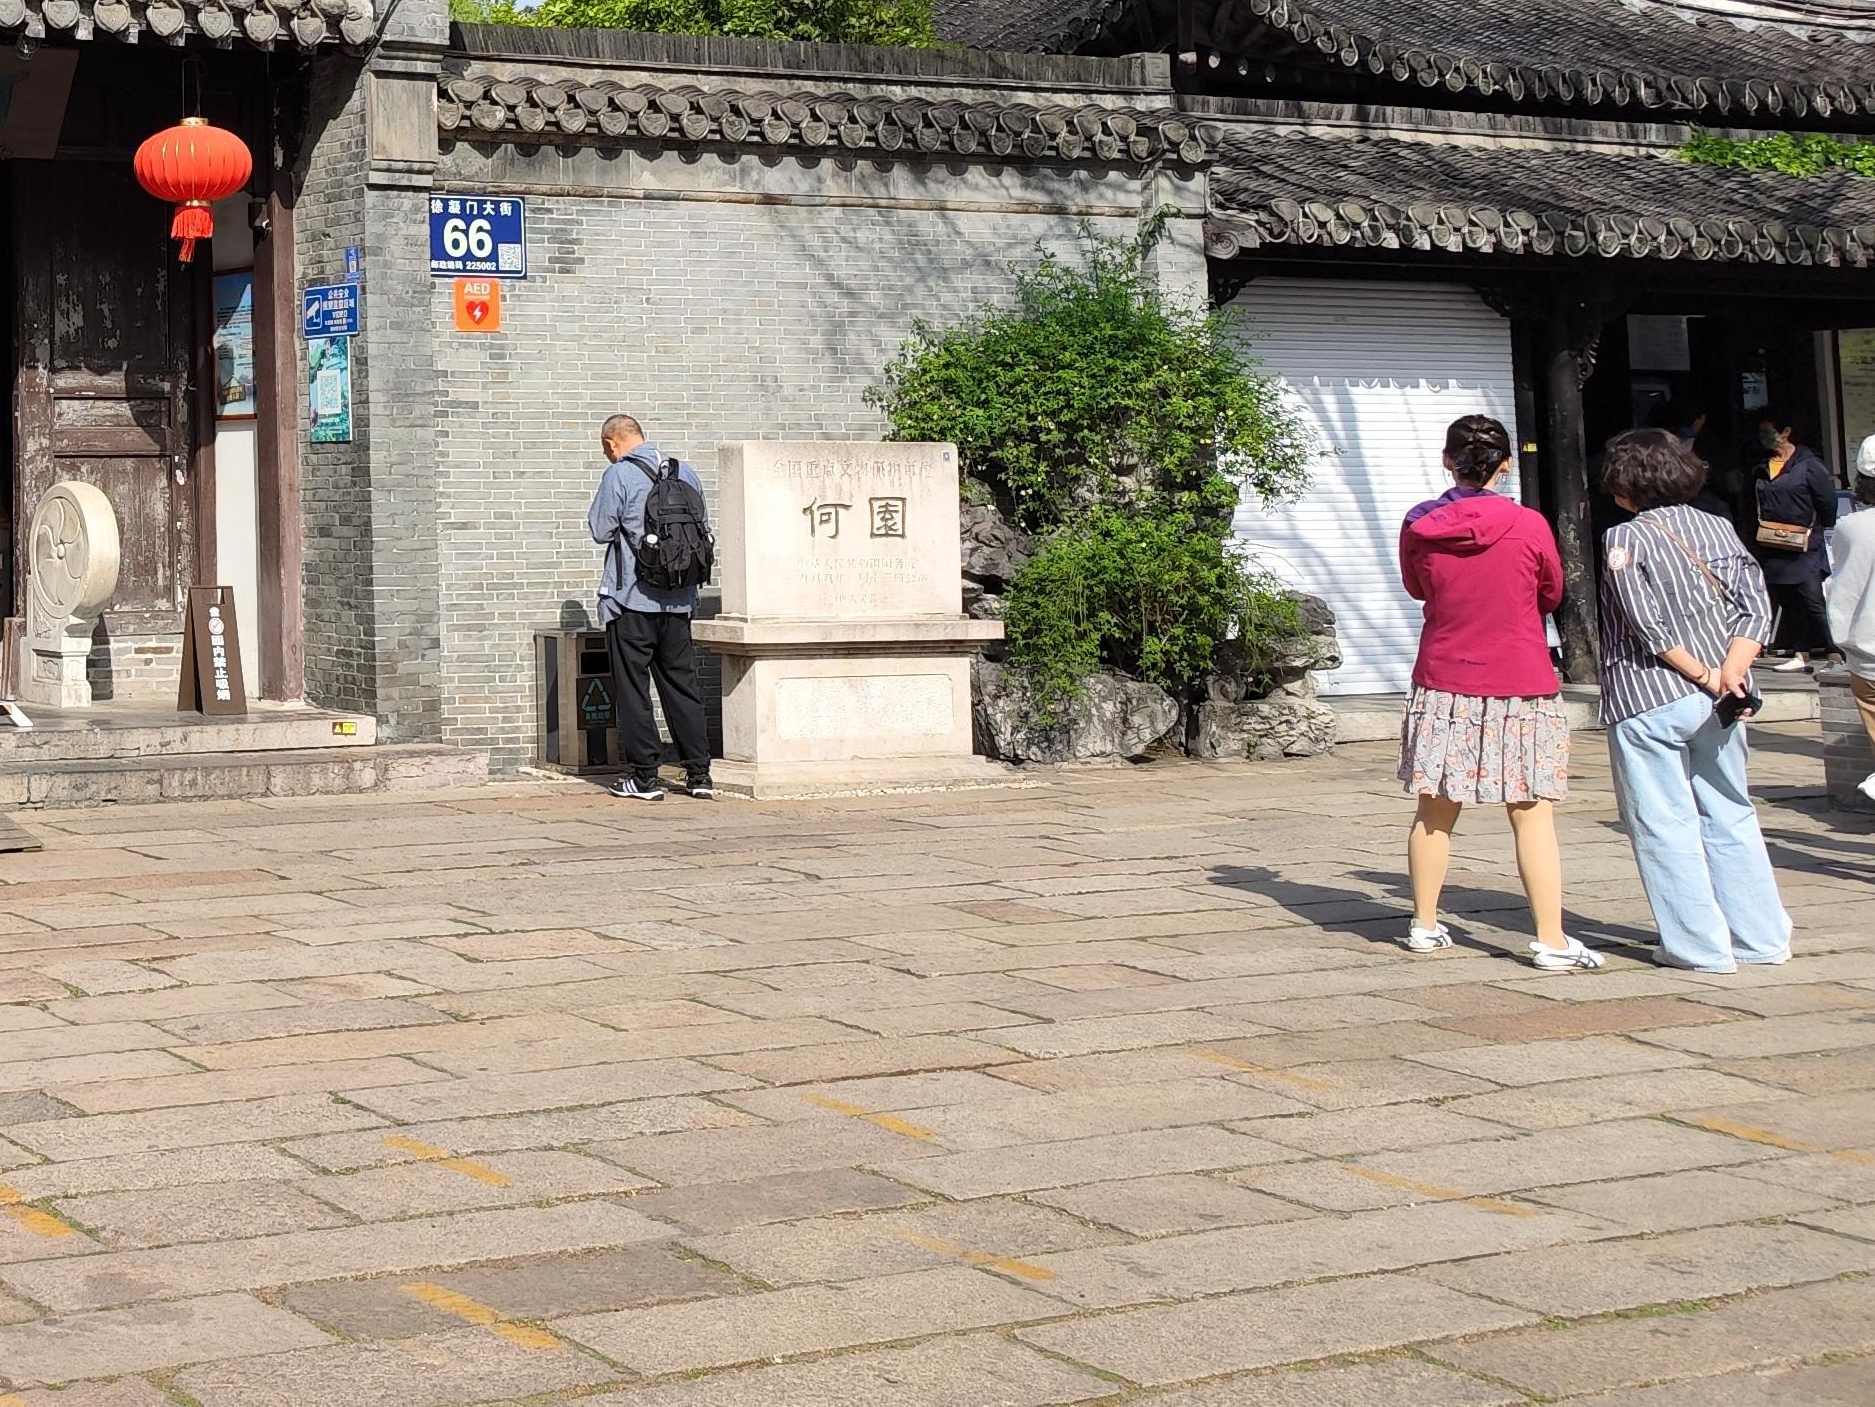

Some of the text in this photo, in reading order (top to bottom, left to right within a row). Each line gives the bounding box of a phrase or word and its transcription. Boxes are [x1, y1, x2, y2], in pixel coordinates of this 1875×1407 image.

[431, 199, 513, 217] 徐凝门大街
[443, 218, 493, 258] 66
[466, 261, 497, 270] 225002
[463, 282, 491, 294] AED
